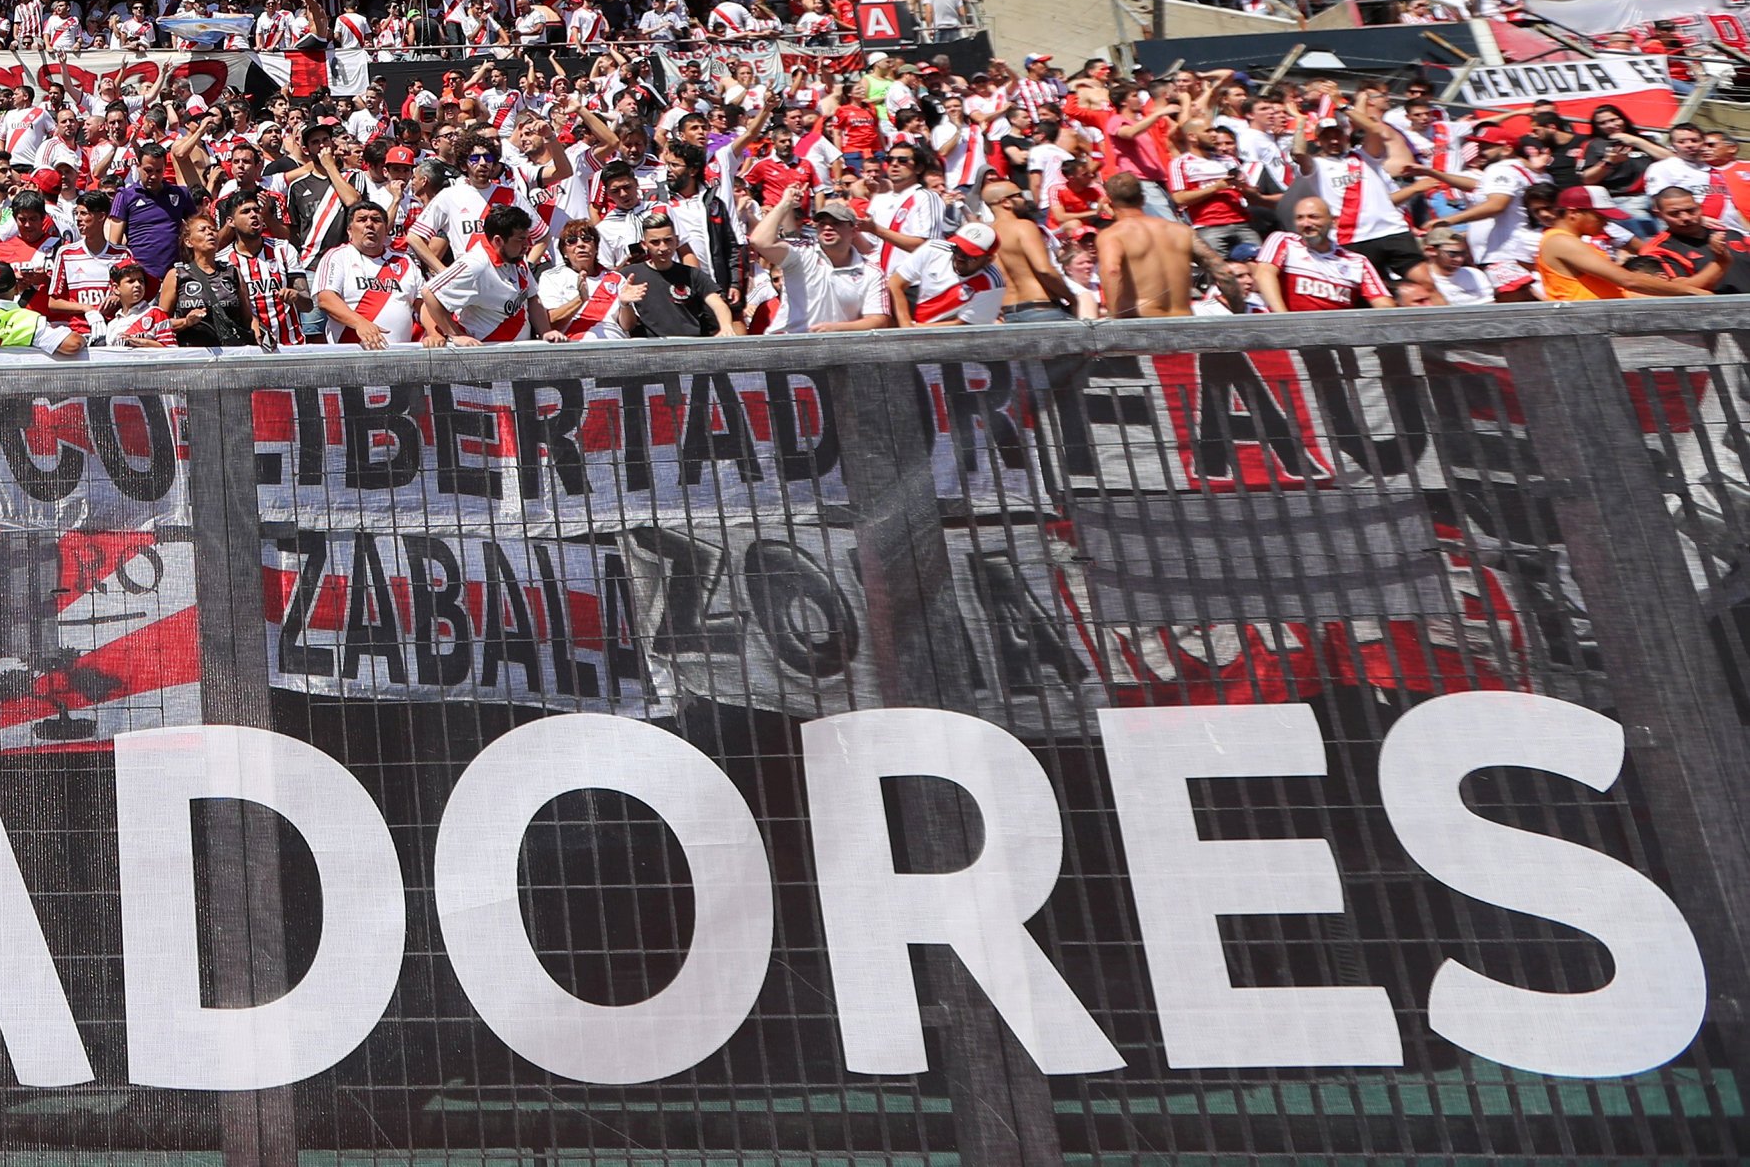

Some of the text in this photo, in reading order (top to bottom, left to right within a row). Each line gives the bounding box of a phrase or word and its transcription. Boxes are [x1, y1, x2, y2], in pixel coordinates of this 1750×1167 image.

[865, 5, 901, 37] A
[1471, 62, 1618, 101] MENDOZA
[462, 220, 485, 235] BB
[247, 277, 283, 296] BVA
[355, 276, 403, 294] BBVA
